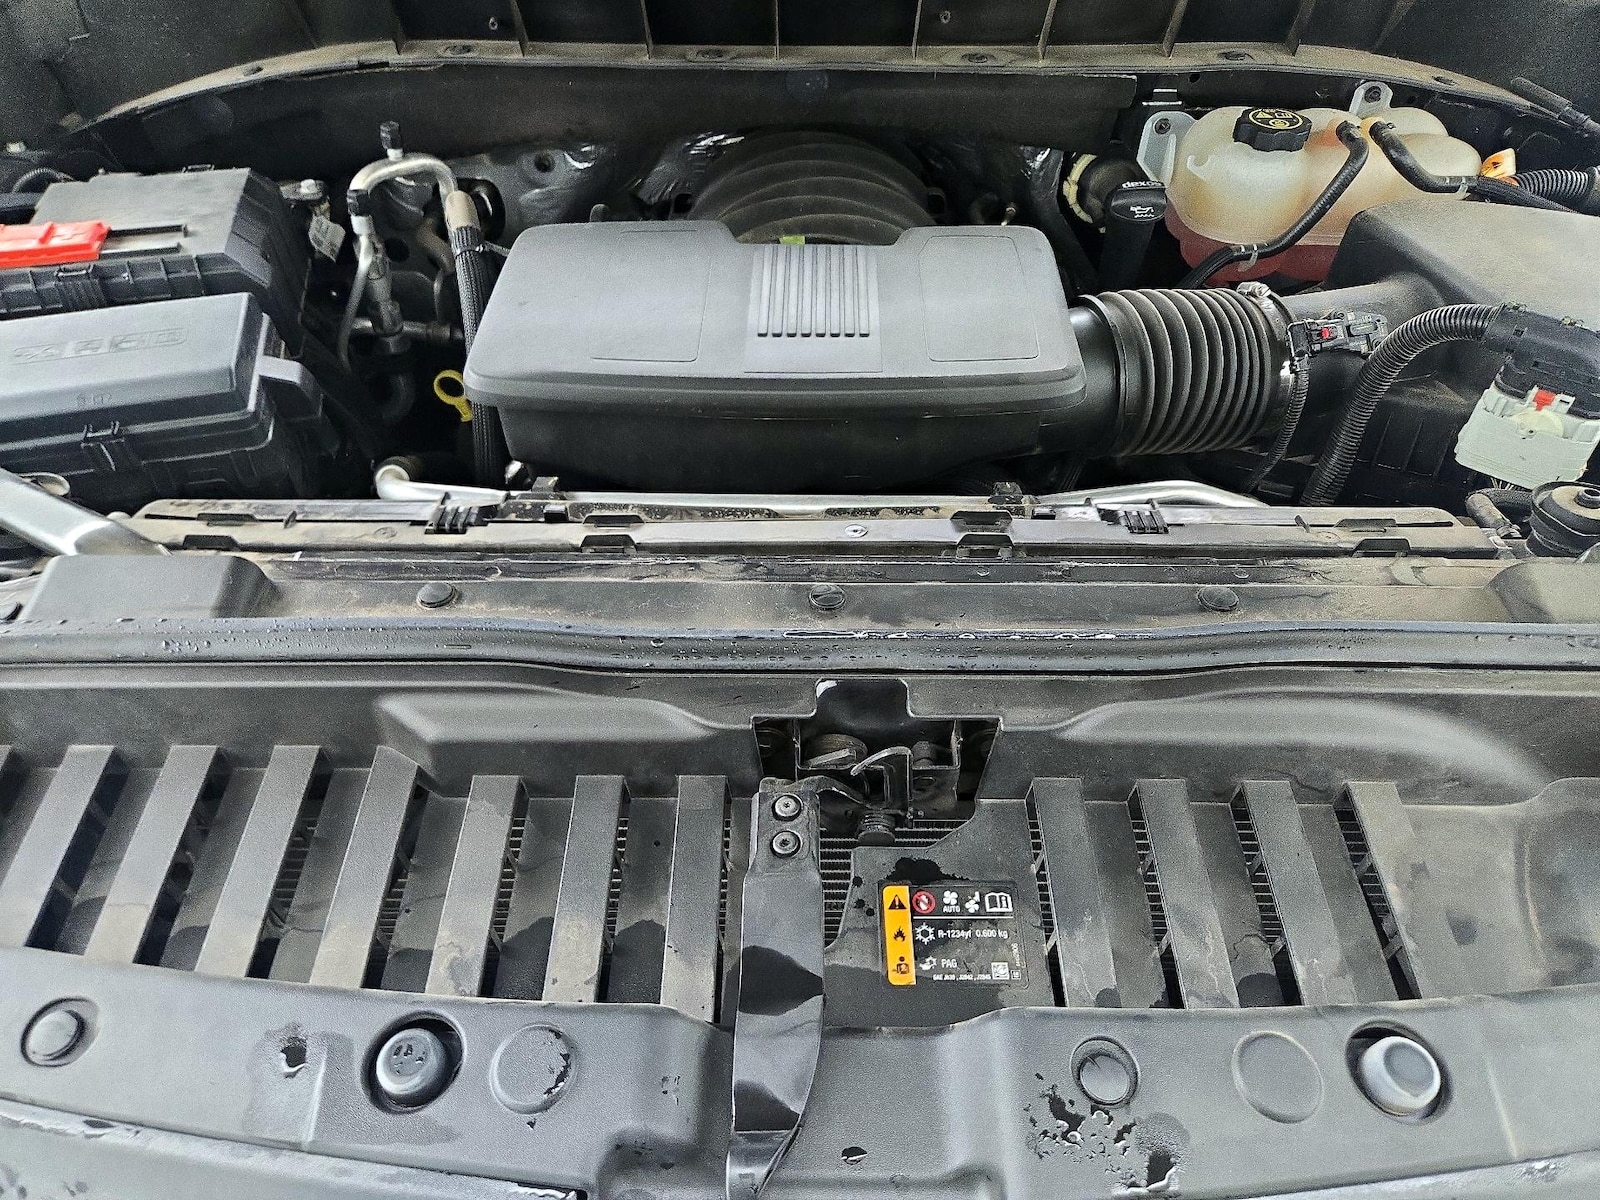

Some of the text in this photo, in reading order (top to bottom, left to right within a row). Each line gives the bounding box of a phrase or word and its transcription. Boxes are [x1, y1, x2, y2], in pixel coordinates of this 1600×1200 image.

[943, 905, 961, 913] AUTO
[937, 929, 1009, 939] R-1234yf 0.600 kg
[941, 959, 958, 968] PAG
